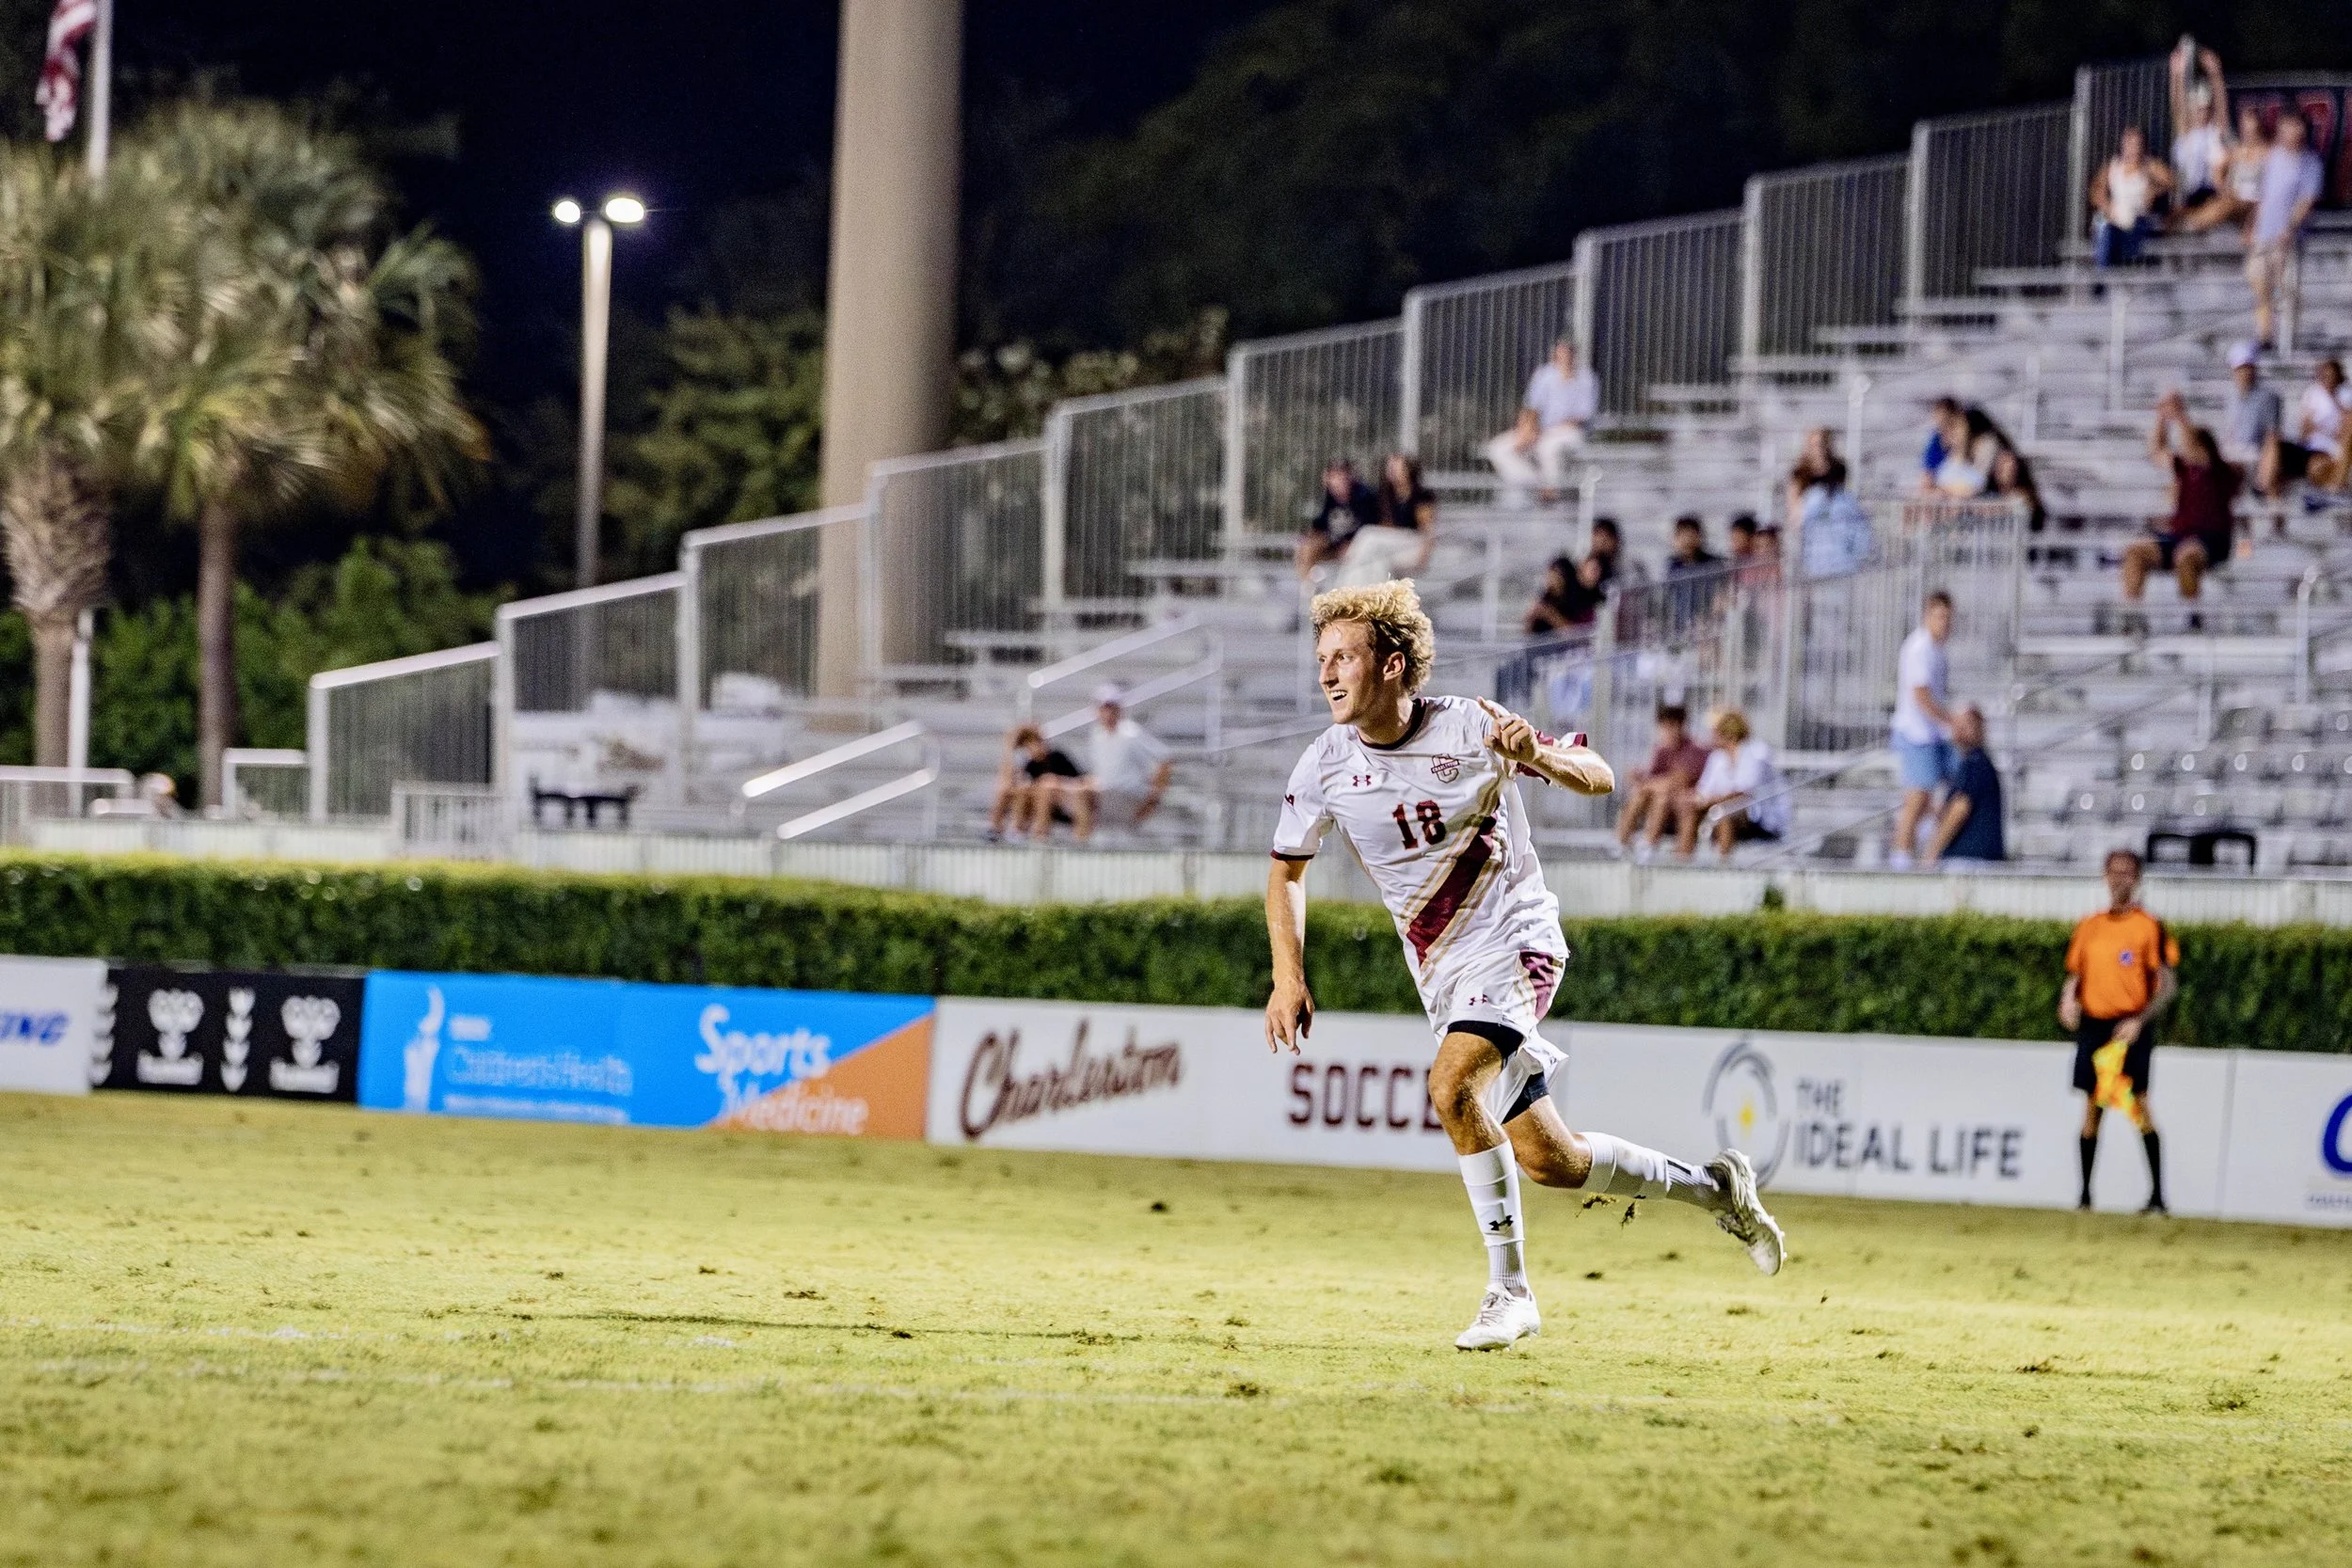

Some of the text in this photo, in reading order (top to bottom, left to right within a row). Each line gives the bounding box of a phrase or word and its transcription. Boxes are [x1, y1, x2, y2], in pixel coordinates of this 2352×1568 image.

[1391, 800, 1447, 850] 18
[694, 1004, 831, 1085] Sports
[719, 1080, 870, 1135] Medicine
[960, 1017, 1184, 1141] Charleston
[1290, 1064, 1445, 1131] SOCCE
[1795, 1078, 1845, 1116] THE
[1793, 1120, 2025, 1179] IDEAL LIFE
